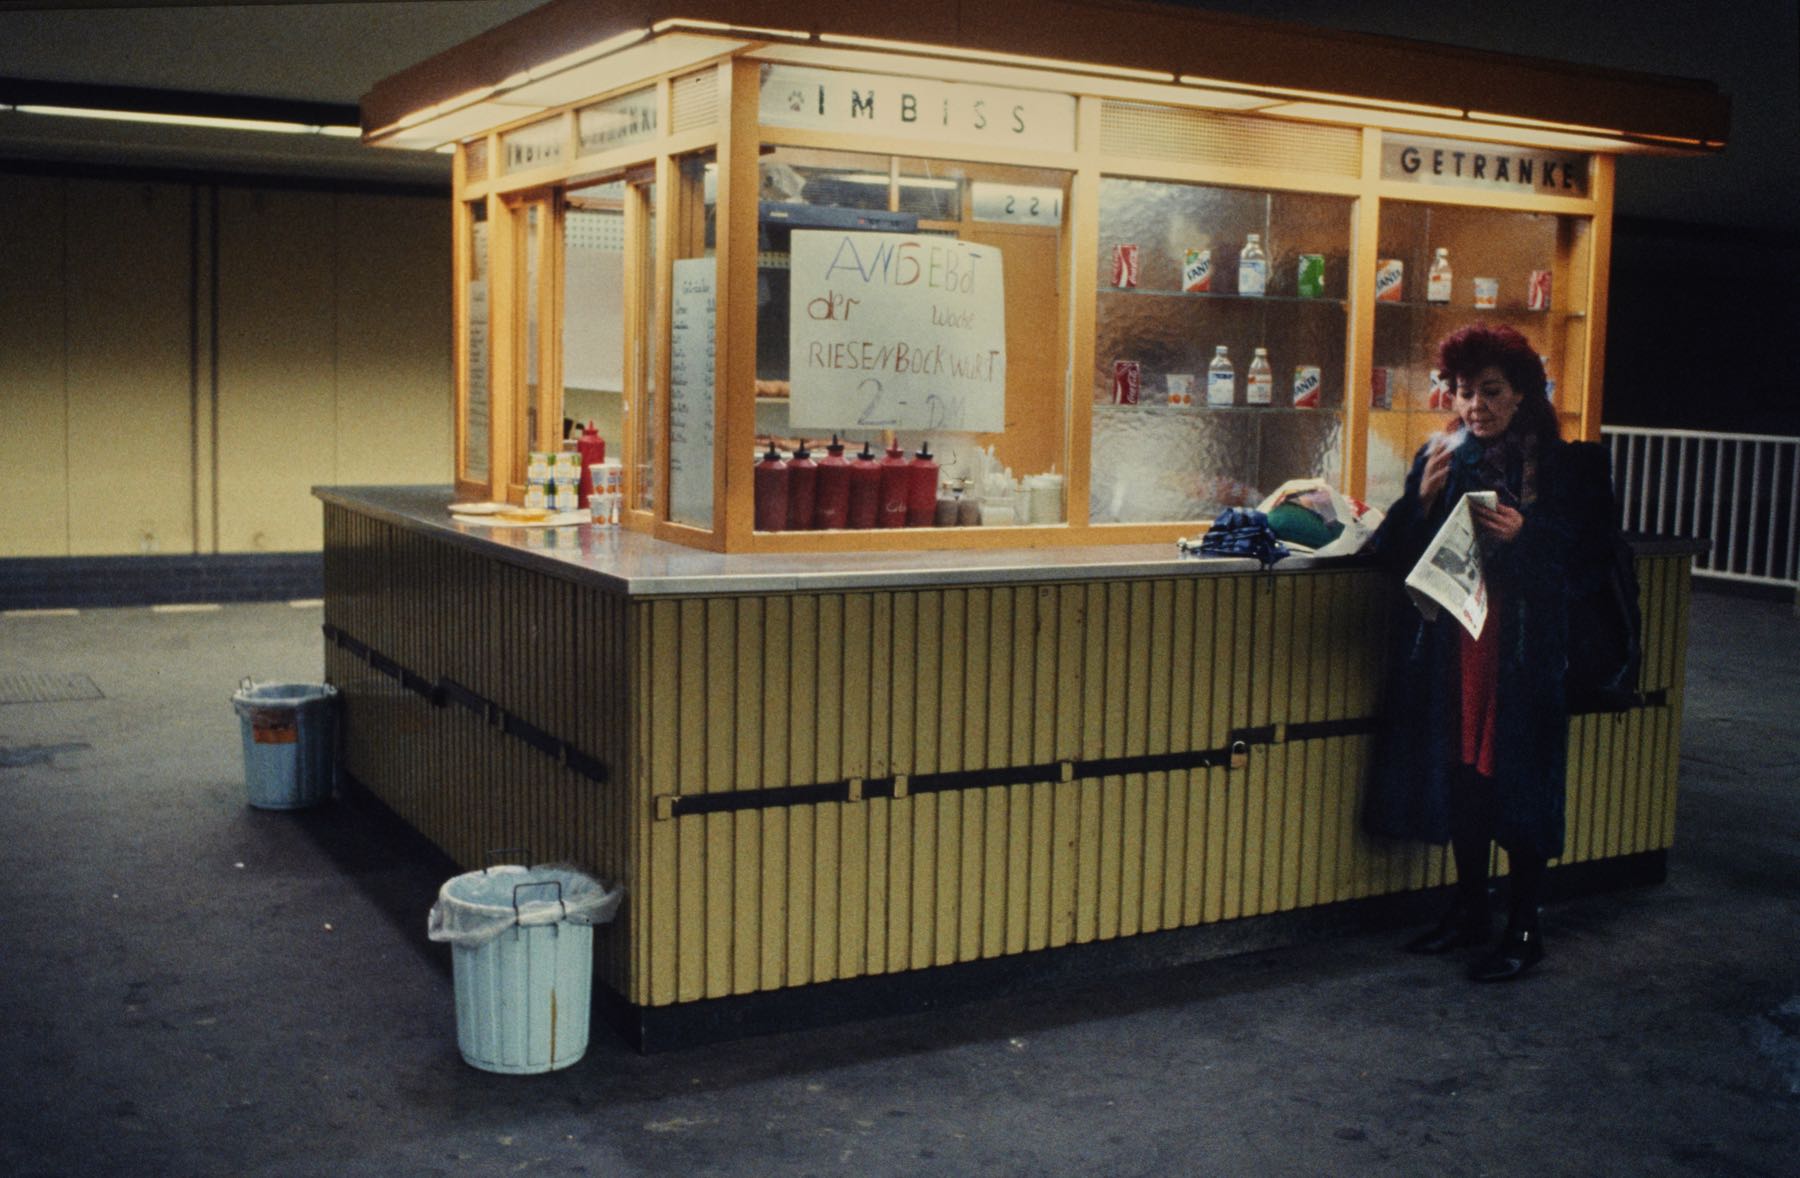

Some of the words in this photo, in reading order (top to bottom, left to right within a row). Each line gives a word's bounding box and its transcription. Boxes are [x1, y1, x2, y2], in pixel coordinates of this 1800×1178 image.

[818, 84, 1025, 134] IMBISS
[1401, 146, 1573, 189] GETRÄNKE
[807, 289, 861, 321] der
